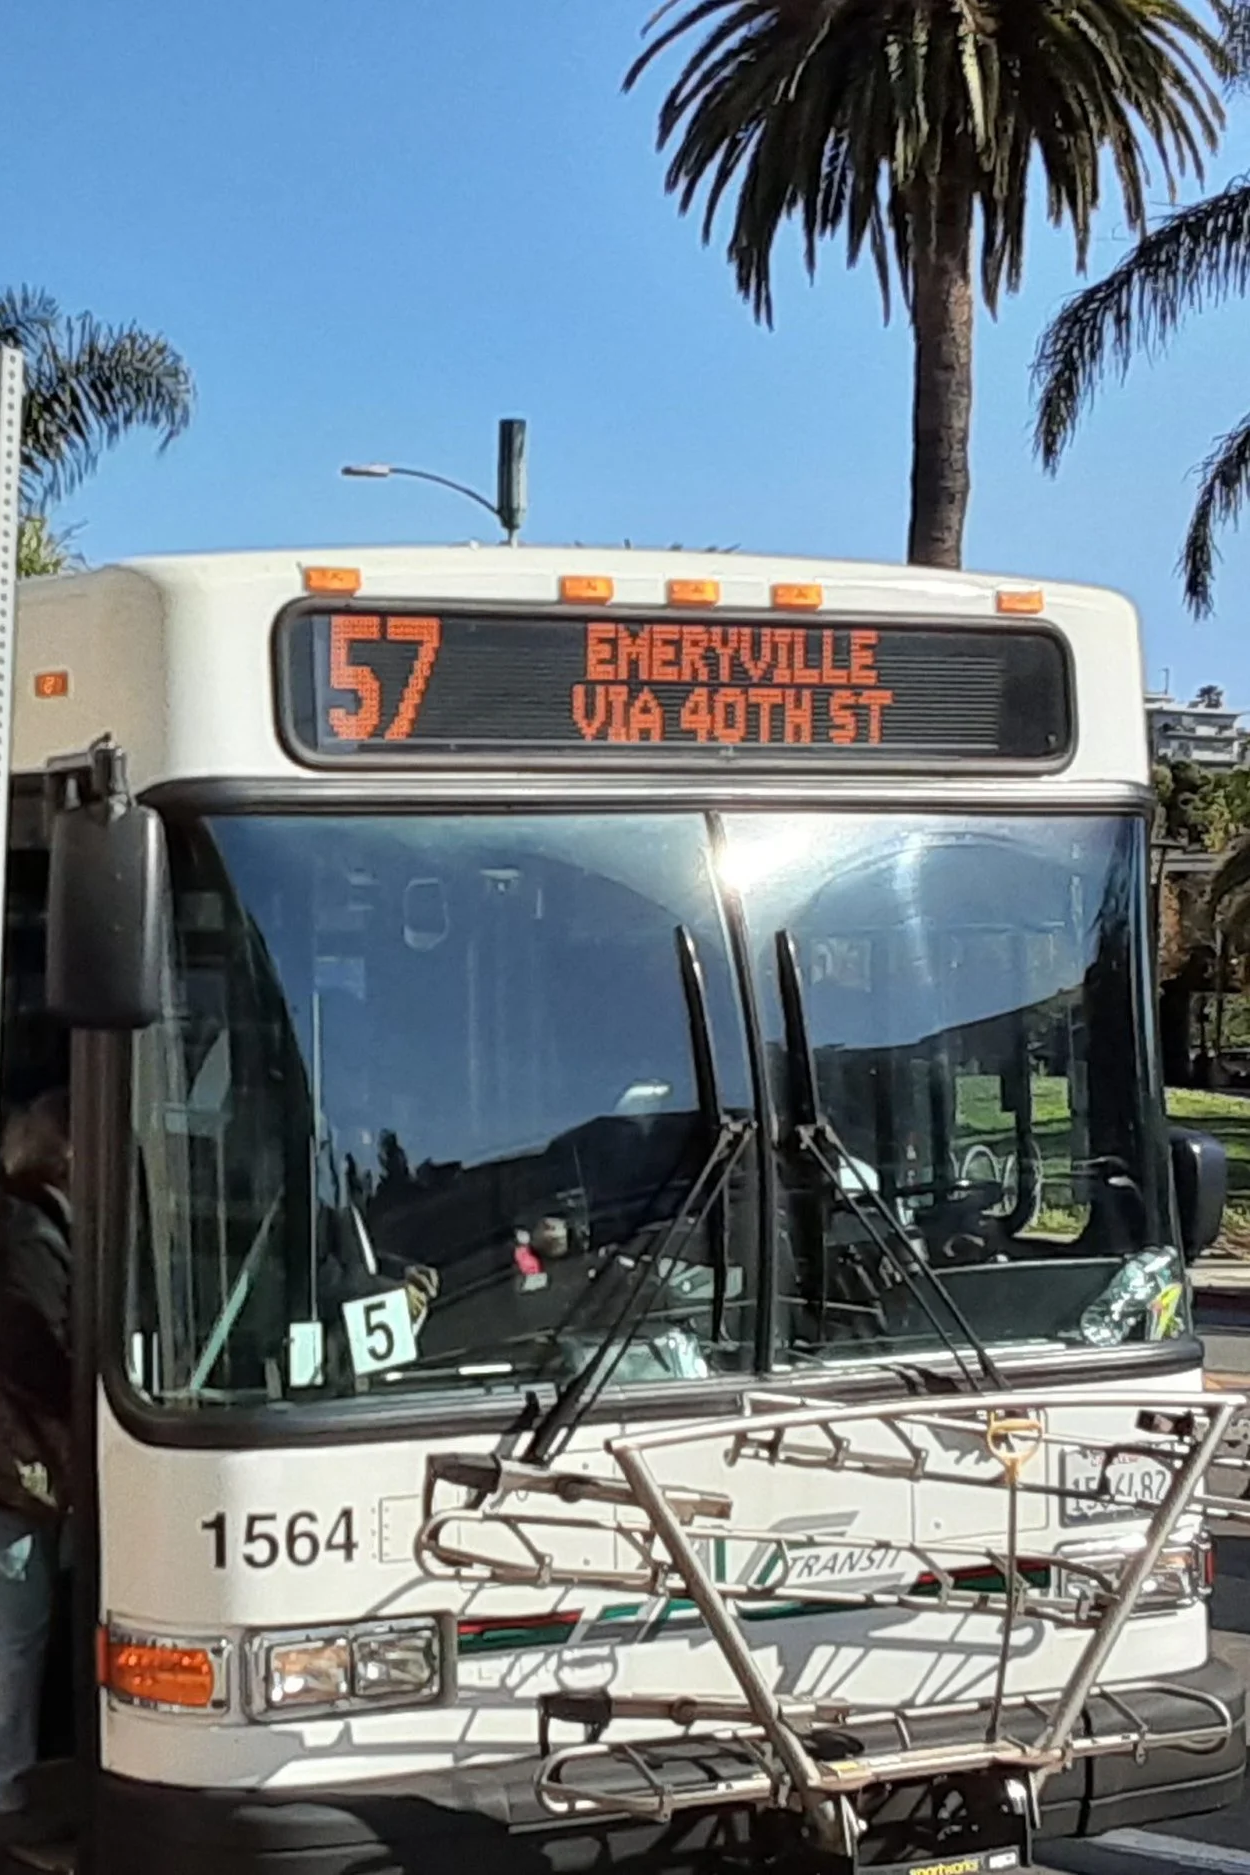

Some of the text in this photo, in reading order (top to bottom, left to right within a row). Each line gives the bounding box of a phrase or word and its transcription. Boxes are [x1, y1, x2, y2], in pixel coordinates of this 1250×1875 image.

[327, 614, 441, 742] 57
[584, 622, 879, 686] EMERYVILLE
[572, 684, 895, 745] VIA 40TH ST
[363, 1299, 395, 1362] 5
[201, 1506, 359, 1569] 1564
[787, 1548, 902, 1580] TRANSIT
